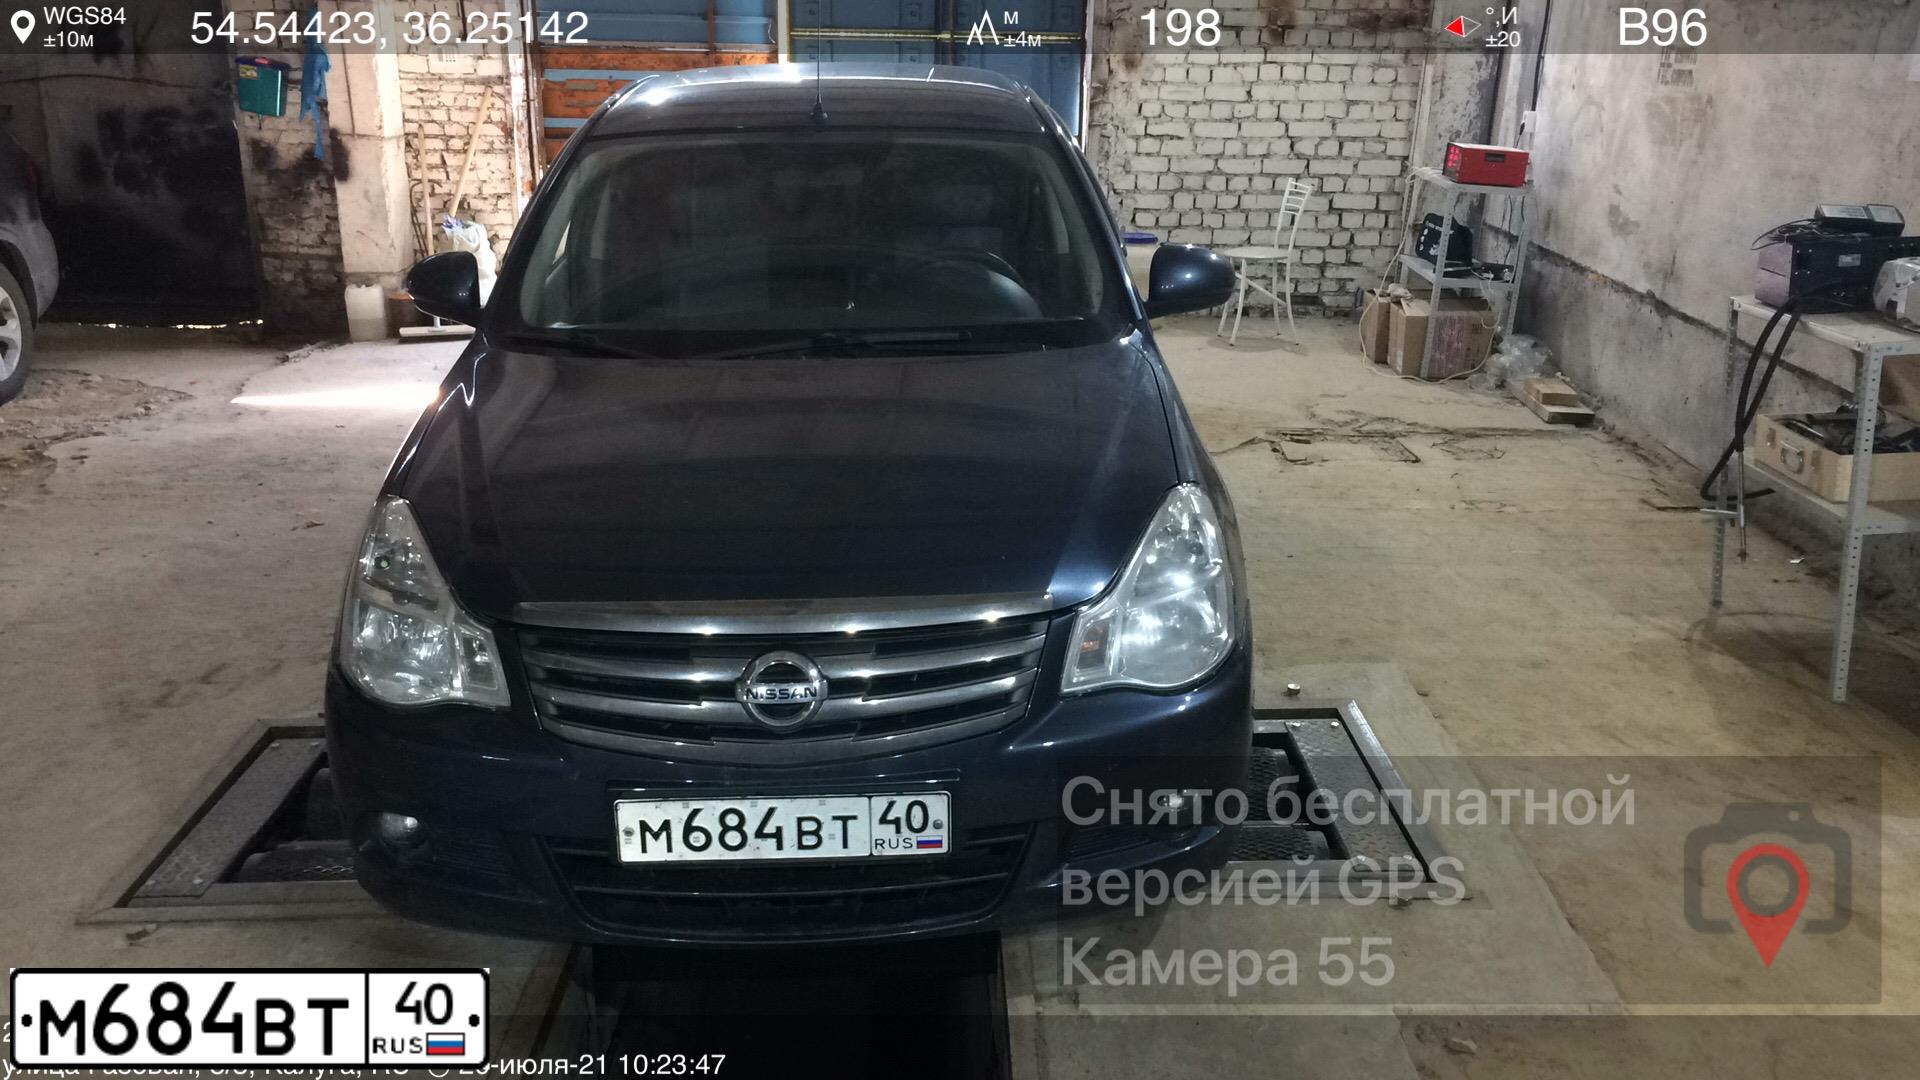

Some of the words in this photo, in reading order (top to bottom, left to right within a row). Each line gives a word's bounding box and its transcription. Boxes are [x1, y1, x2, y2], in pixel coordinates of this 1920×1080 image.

[746, 686, 818, 701] NISSAN
[878, 799, 930, 834] 40
[874, 836, 914, 850] RUS
